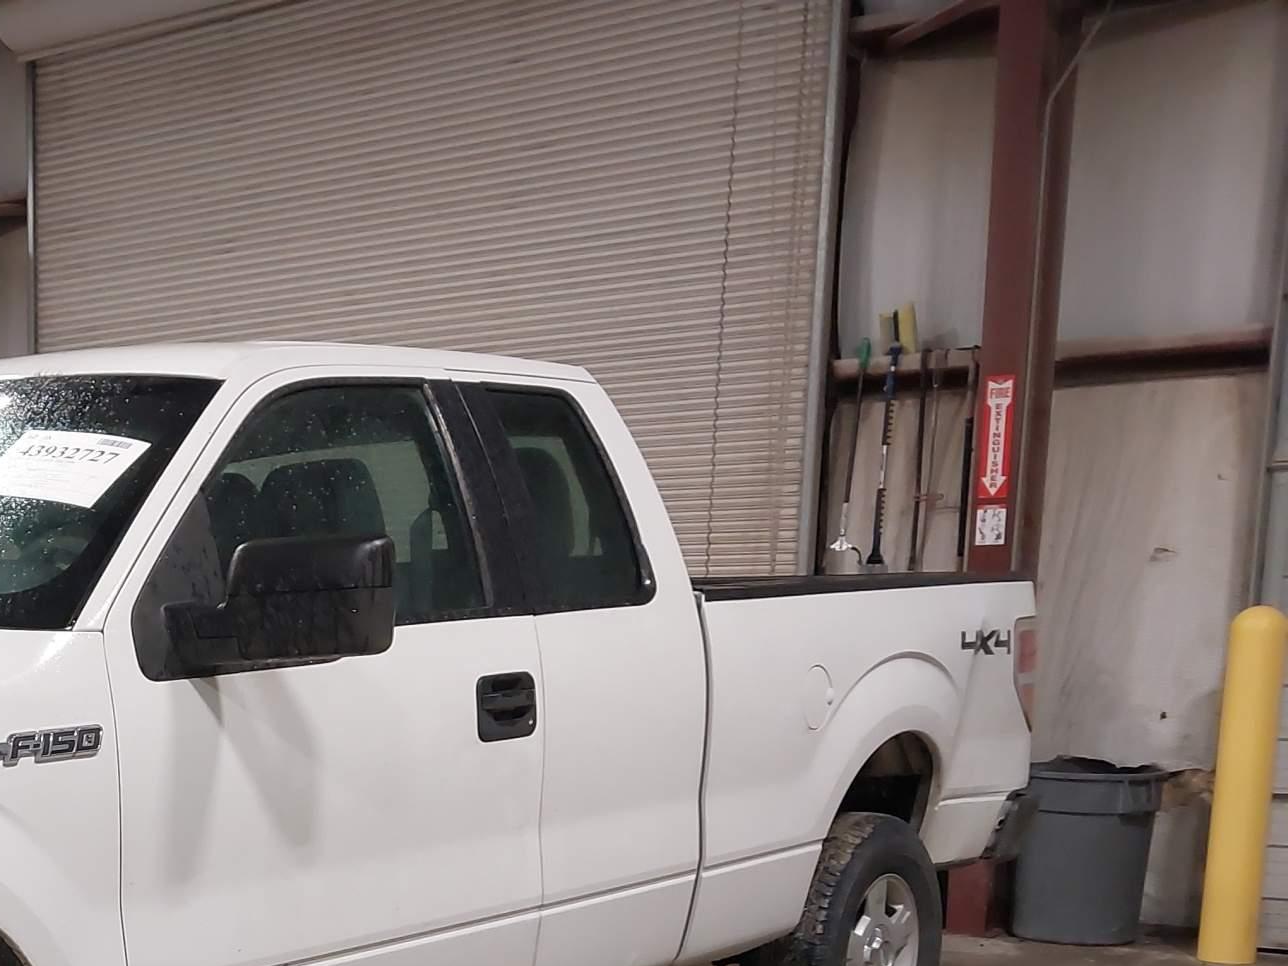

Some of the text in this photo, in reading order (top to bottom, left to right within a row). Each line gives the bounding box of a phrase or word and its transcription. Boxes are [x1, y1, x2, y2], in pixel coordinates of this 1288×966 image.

[990, 387, 1011, 399] FIRE
[18, 444, 120, 464] 43932727
[989, 403, 1003, 489] EXTINGUISHER
[9, 726, 103, 763] F-150
